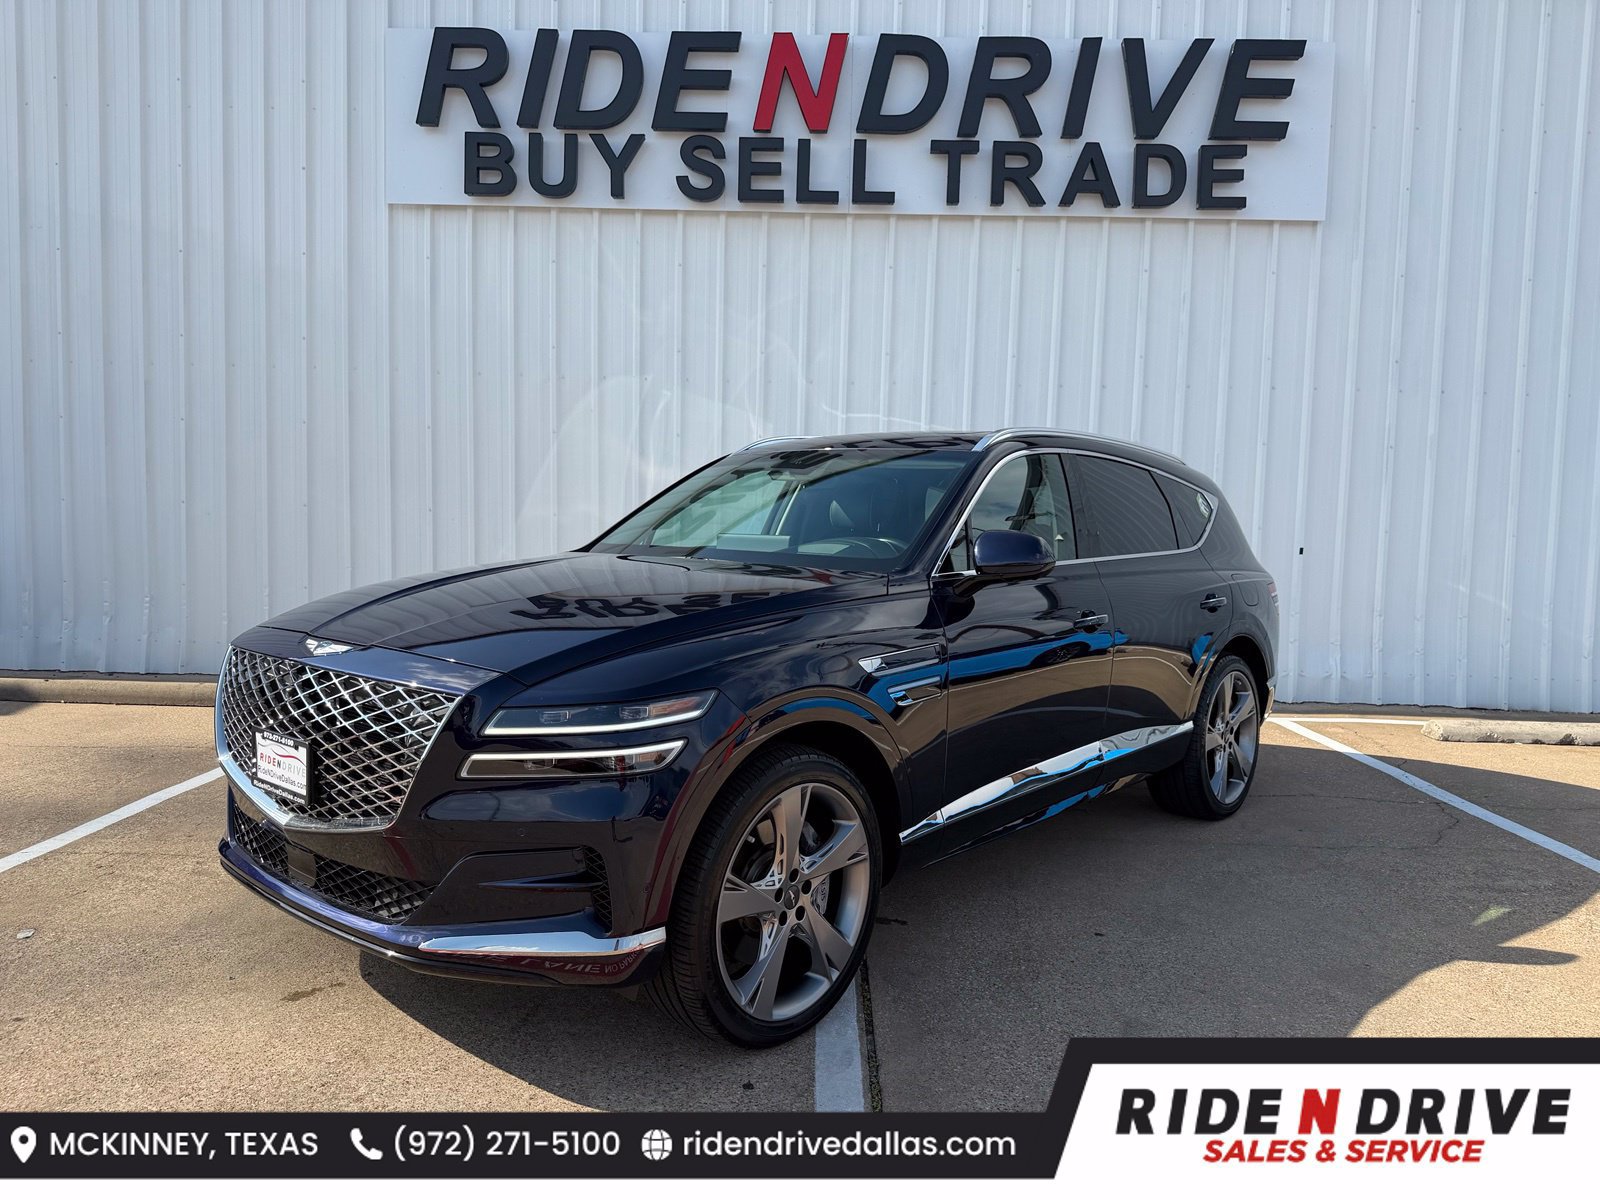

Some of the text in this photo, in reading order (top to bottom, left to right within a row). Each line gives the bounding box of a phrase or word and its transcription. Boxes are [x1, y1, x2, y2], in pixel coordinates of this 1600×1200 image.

[464, 131, 1248, 210] BUY SELL TRADE
